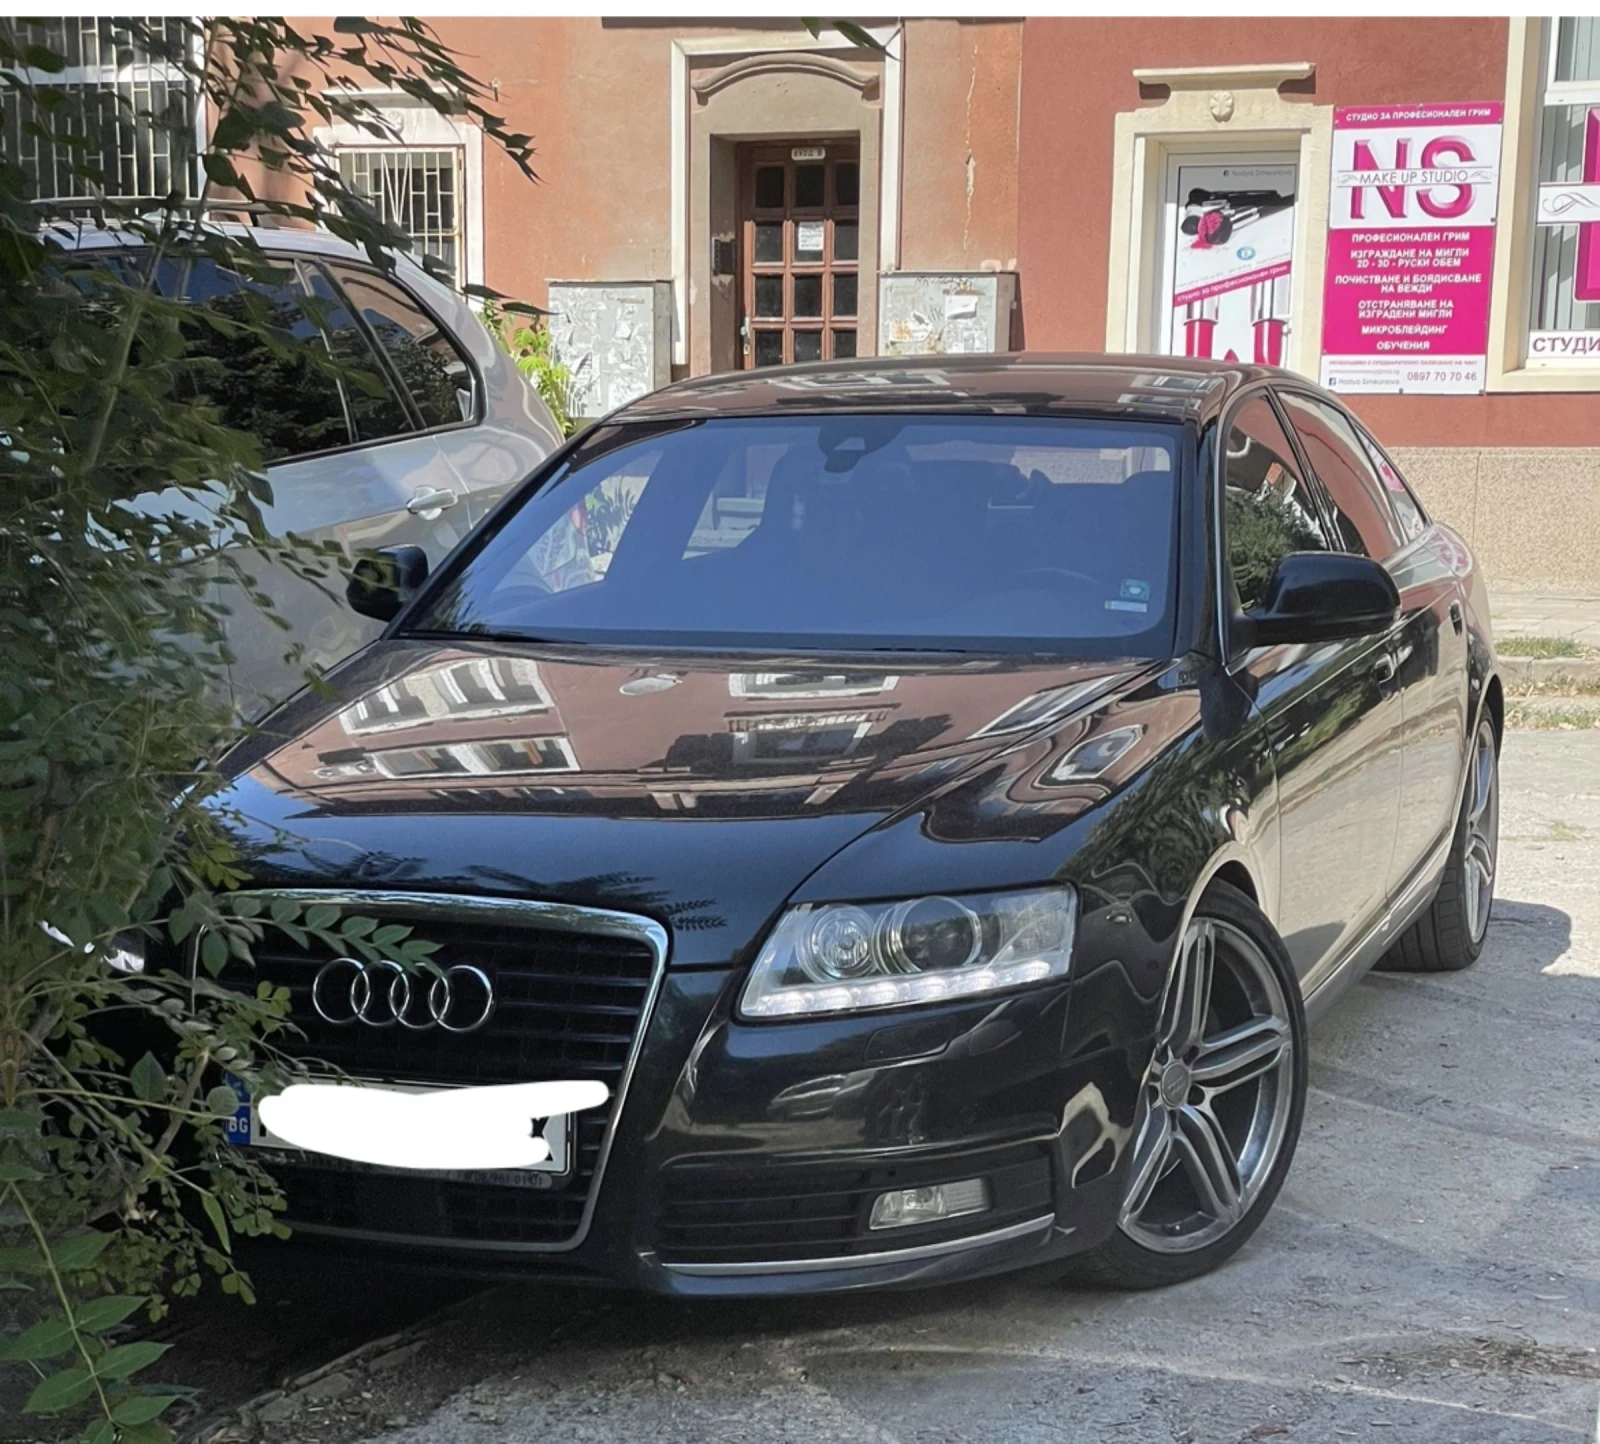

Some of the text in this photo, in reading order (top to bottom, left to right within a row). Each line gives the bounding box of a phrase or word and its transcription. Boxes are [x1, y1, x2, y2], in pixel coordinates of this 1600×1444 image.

[1346, 108, 1491, 122] СТУДИО ЗА ПРОФЕСИОНАЛЕН ГРИМ
[1350, 135, 1477, 219] NS
[1359, 170, 1469, 184] MAKE UP STUDIO
[1352, 232, 1470, 243] ПРОФЕСИОНАЛЕН ГРИМ
[1350, 248, 1470, 259] ИЗГРАЖДАНЕ НА МИГЛИ
[1357, 259, 1369, 268] 2D
[1378, 259, 1390, 267] 3D
[1398, 259, 1430, 268] РУСКИ
[1432, 258, 1461, 267] ОБЕМ
[1335, 273, 1482, 285] ПОЧИСТВАНЕ И БОЯДИСВАНЕ
[1381, 284, 1433, 294] НА ВЕЖДИ
[1358, 300, 1454, 309] ОТСТРАНЯВАНЕ НА
[1358, 309, 1453, 319] ИЗГРАДЕНИ МИГЛИ
[1361, 324, 1448, 336] МИКРОБЛЕЙДИНГ
[1376, 340, 1430, 351] ОБУЧЕНИЯ
[1532, 336, 1600, 355] СТУДИ
[1407, 371, 1477, 381] 0897 70 70 46
[229, 1116, 249, 1133] BG
